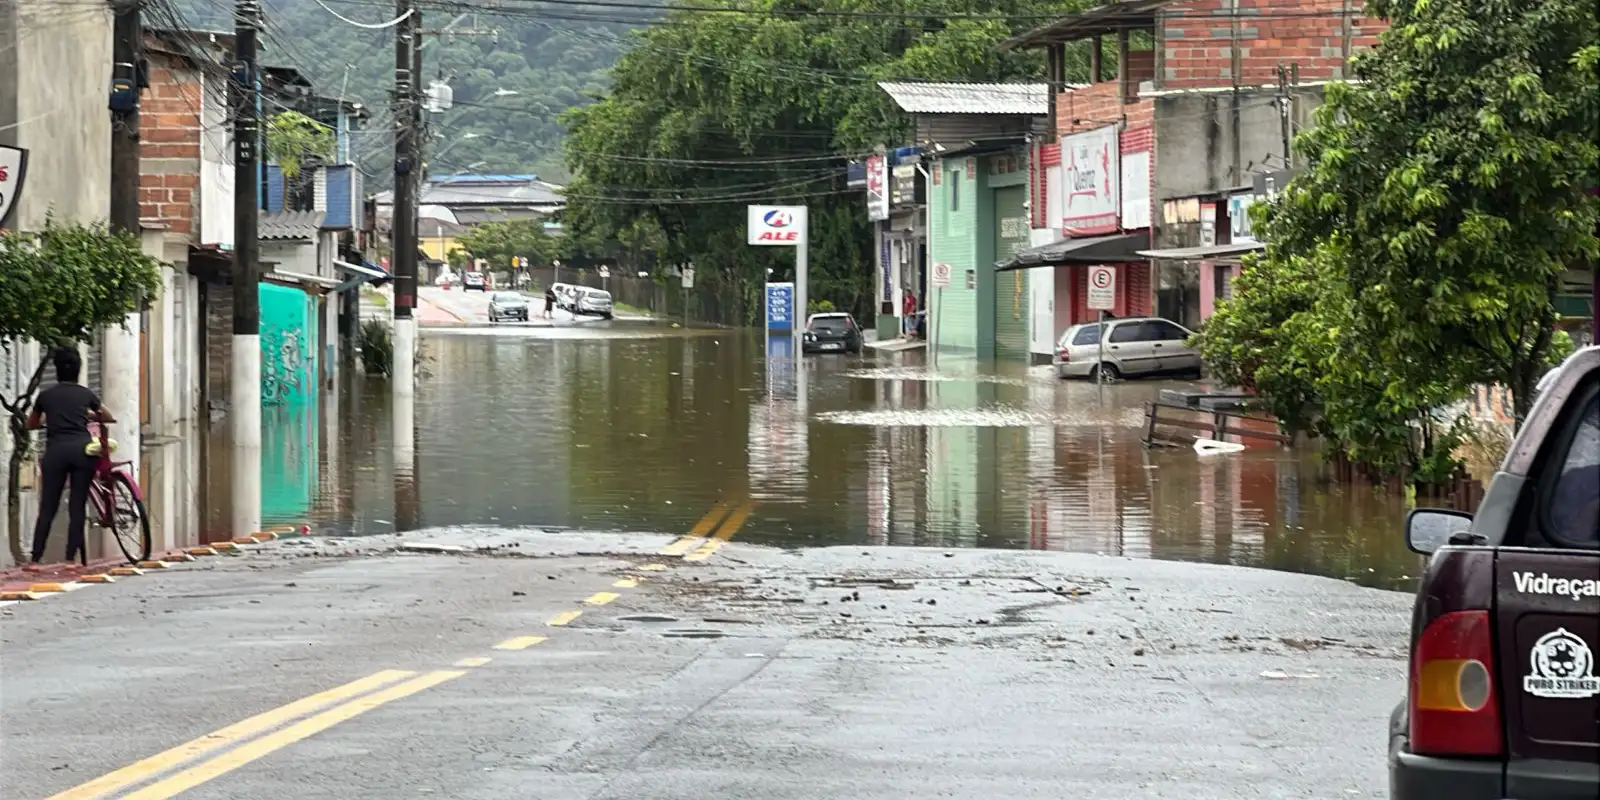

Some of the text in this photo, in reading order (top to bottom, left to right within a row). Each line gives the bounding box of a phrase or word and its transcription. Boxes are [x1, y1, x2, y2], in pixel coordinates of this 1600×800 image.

[757, 231, 798, 241] ALE
[1098, 273, 1106, 285] E
[1528, 679, 1598, 690] PURO STRIKER
